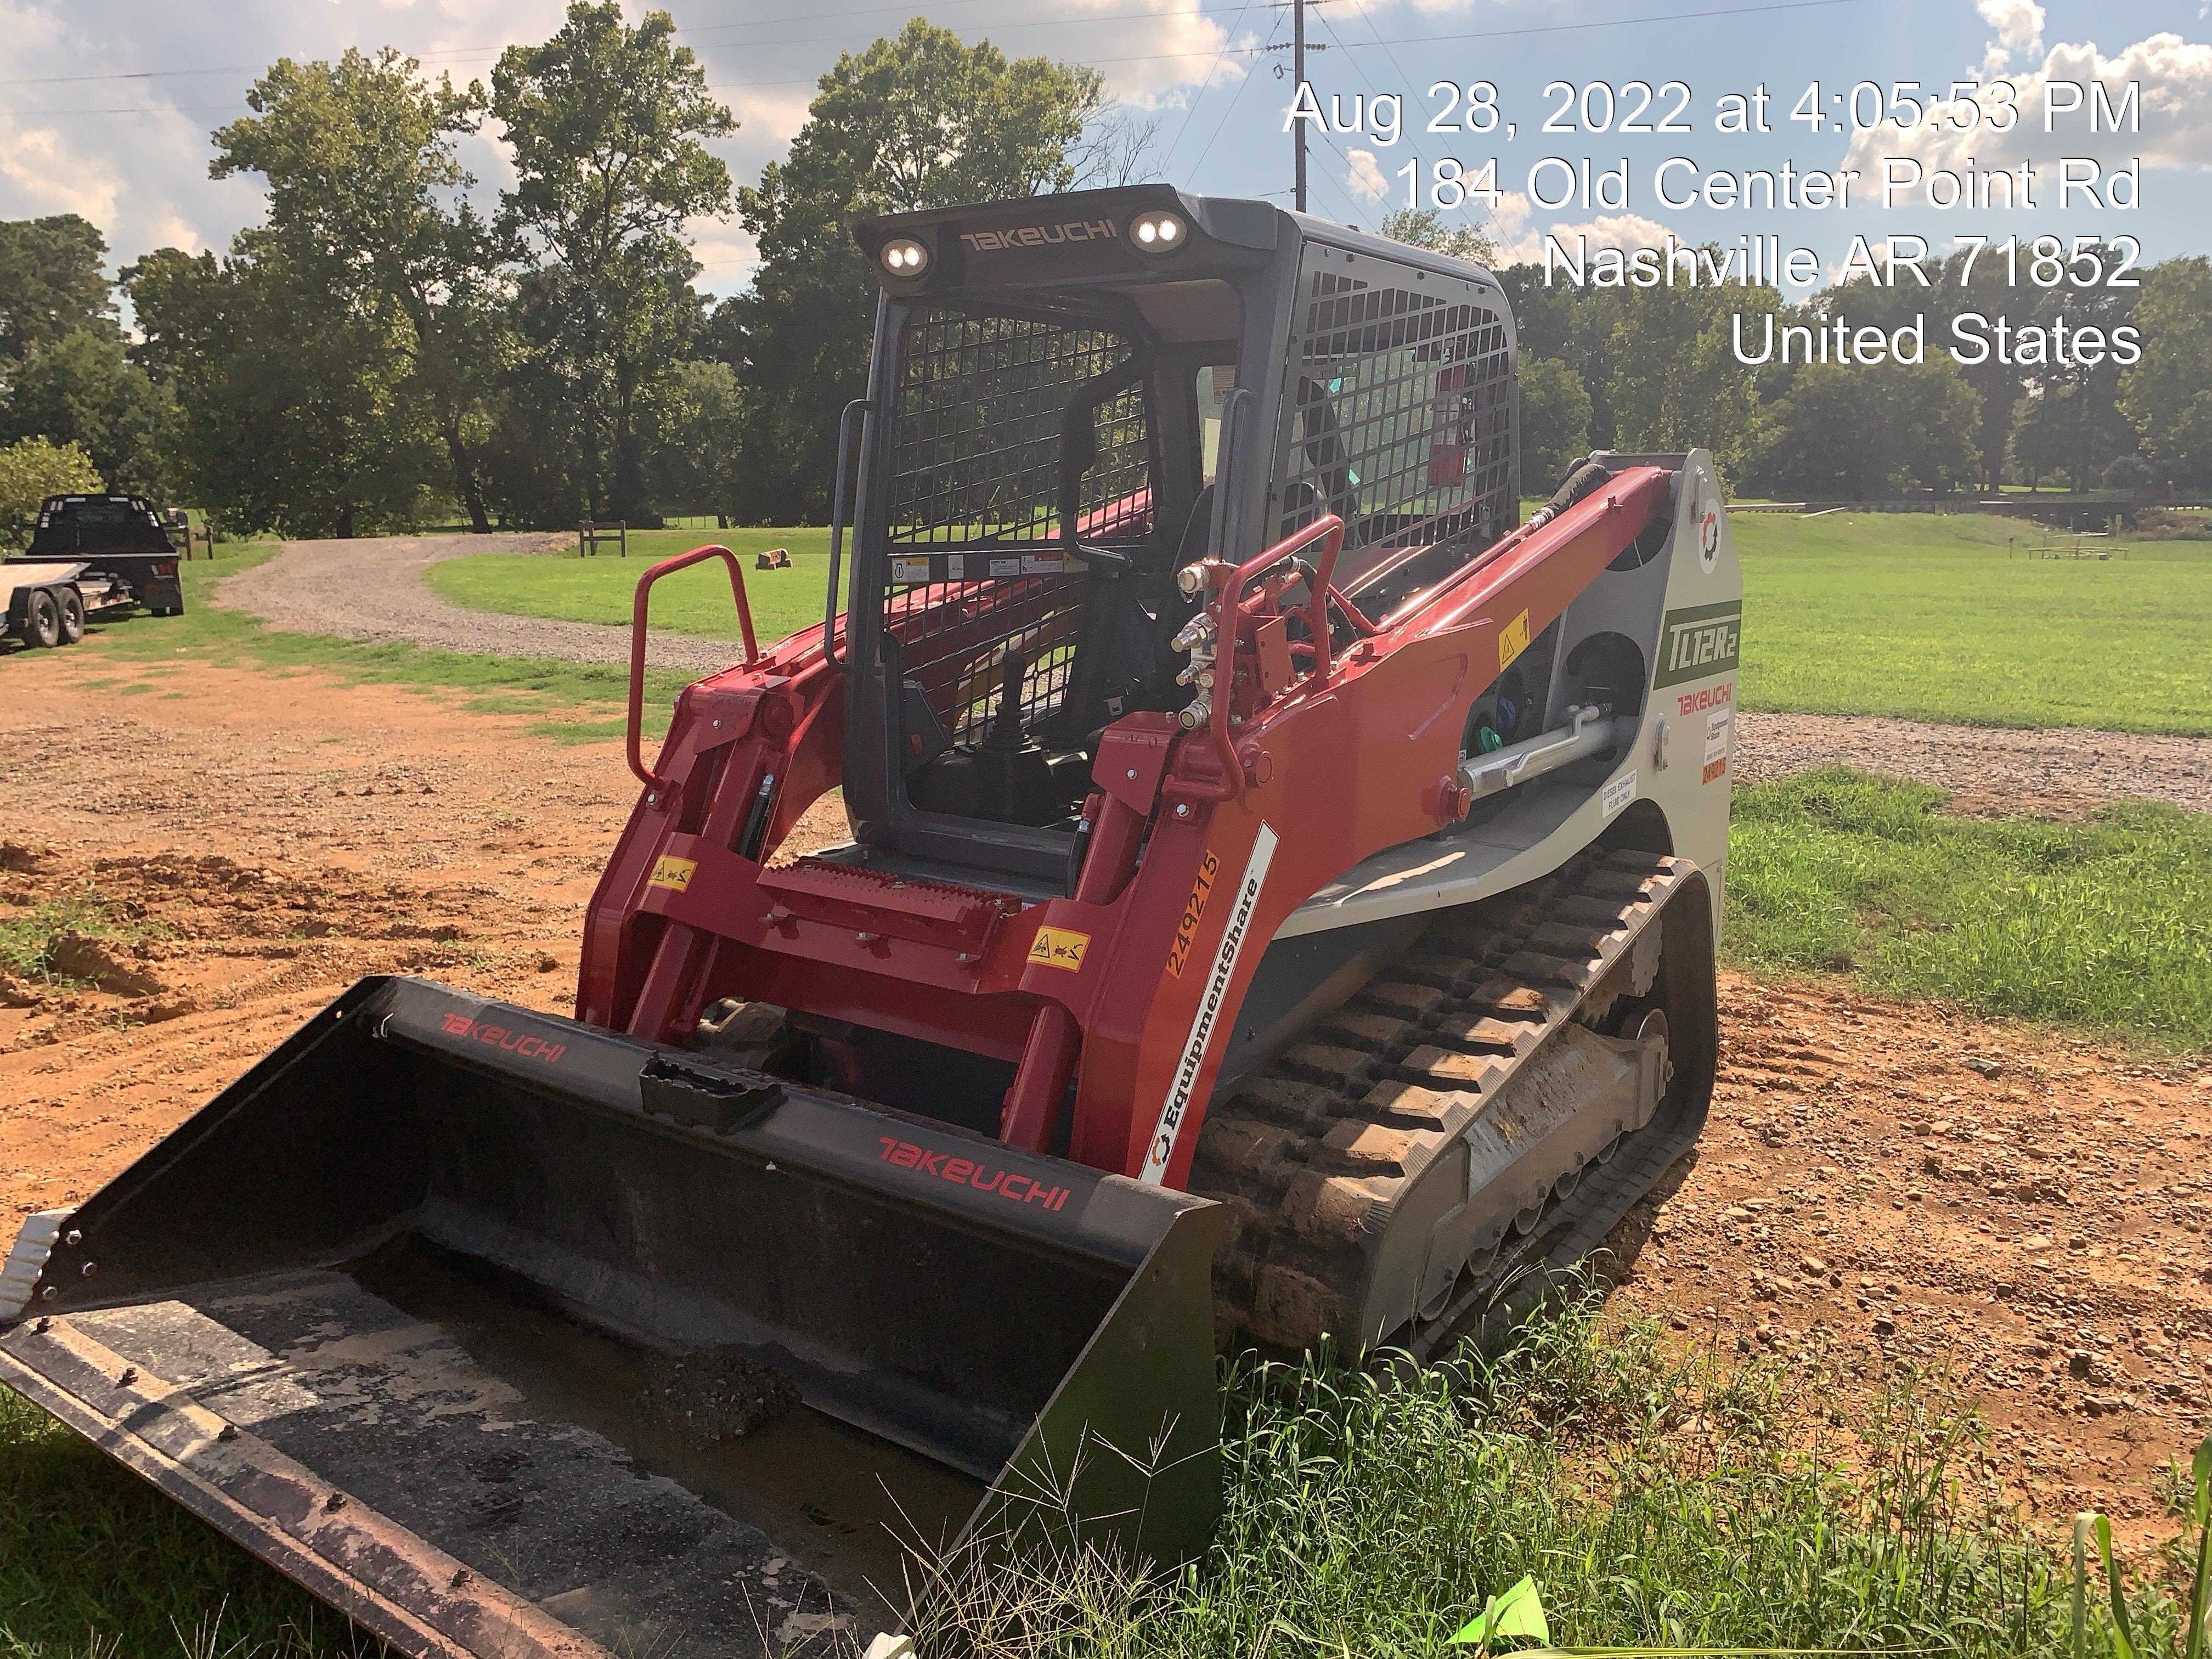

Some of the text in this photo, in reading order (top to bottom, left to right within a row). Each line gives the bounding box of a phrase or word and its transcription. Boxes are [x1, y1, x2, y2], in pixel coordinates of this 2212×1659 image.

[1668, 613, 1741, 672] TL12R2
[1603, 773, 1636, 800] DIESEL EXHAUST
[1609, 789, 1630, 810] FLUID ONLY
[1168, 852, 1217, 975] 249215
[1163, 878, 1257, 1131] EquipmentShare
